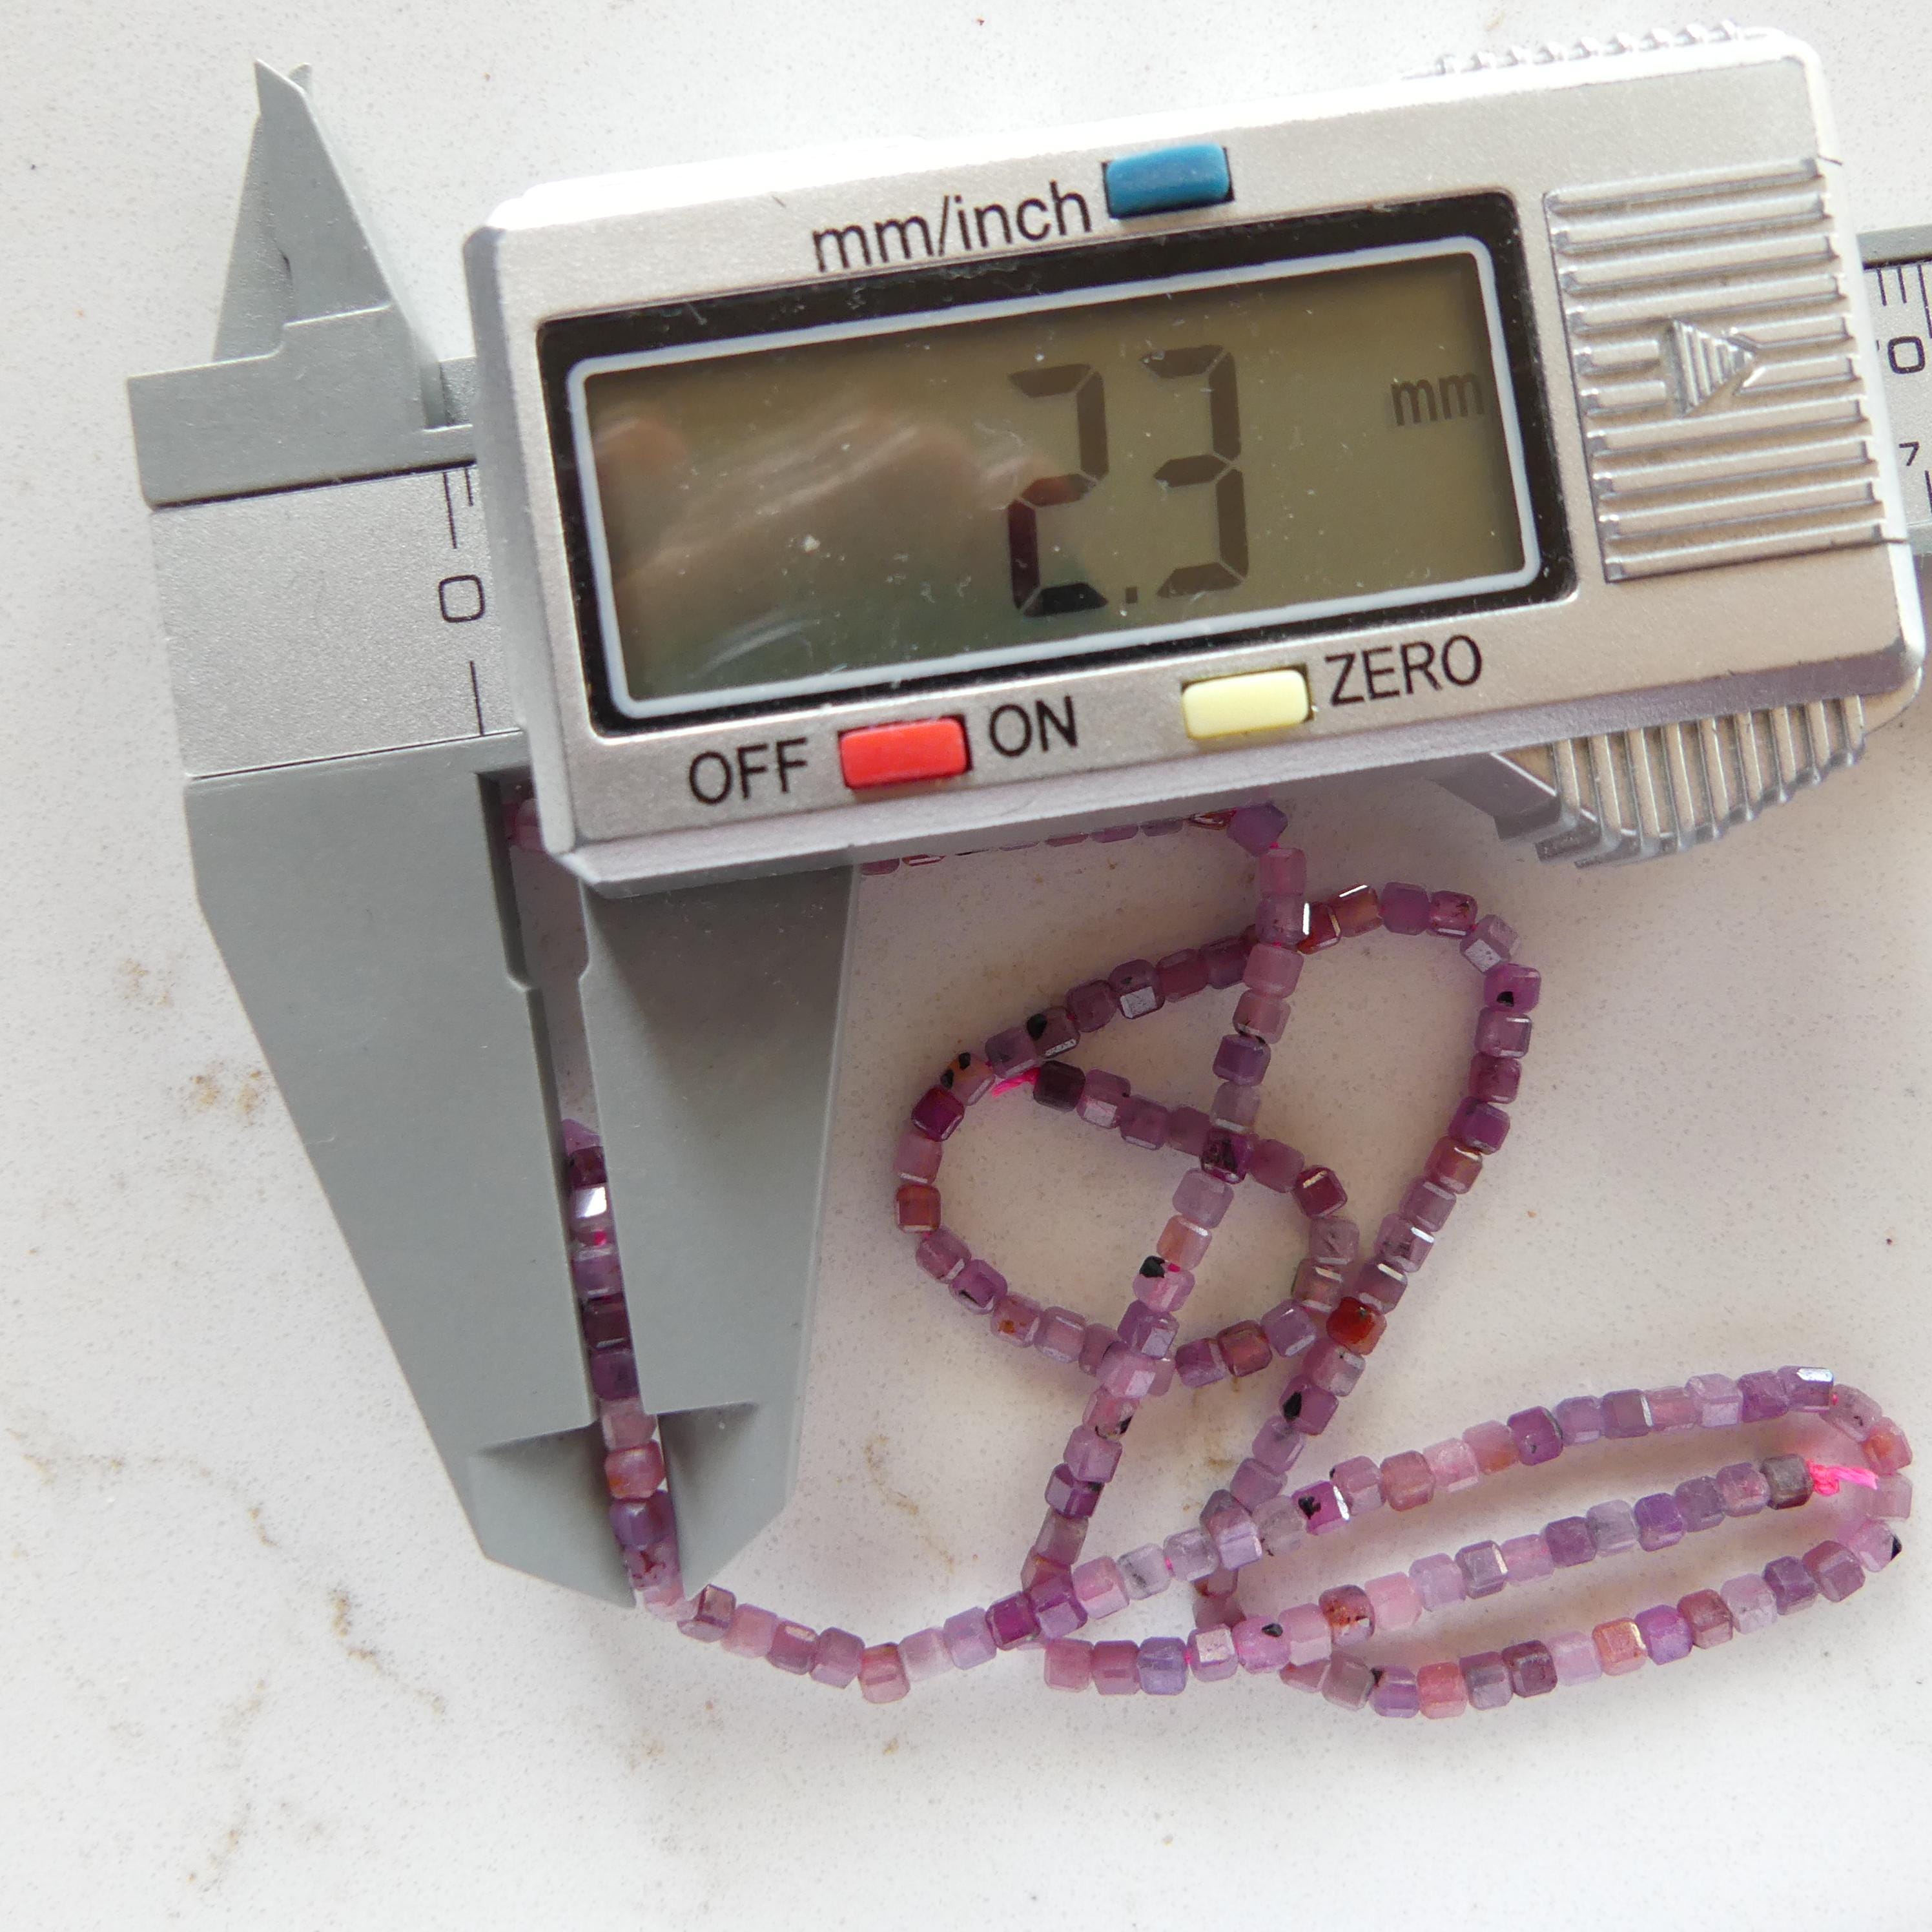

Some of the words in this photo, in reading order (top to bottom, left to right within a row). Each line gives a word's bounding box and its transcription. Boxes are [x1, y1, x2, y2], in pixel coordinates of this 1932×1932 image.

[811, 180, 1092, 272] mm/inch
[1876, 336, 1926, 375] 0
[1007, 344, 1249, 618] 2.3
[1390, 371, 1485, 426] mm
[438, 574, 485, 623] 0
[1324, 634, 1483, 706] ZERO
[989, 695, 1078, 757] ON
[688, 737, 808, 805] OFF
